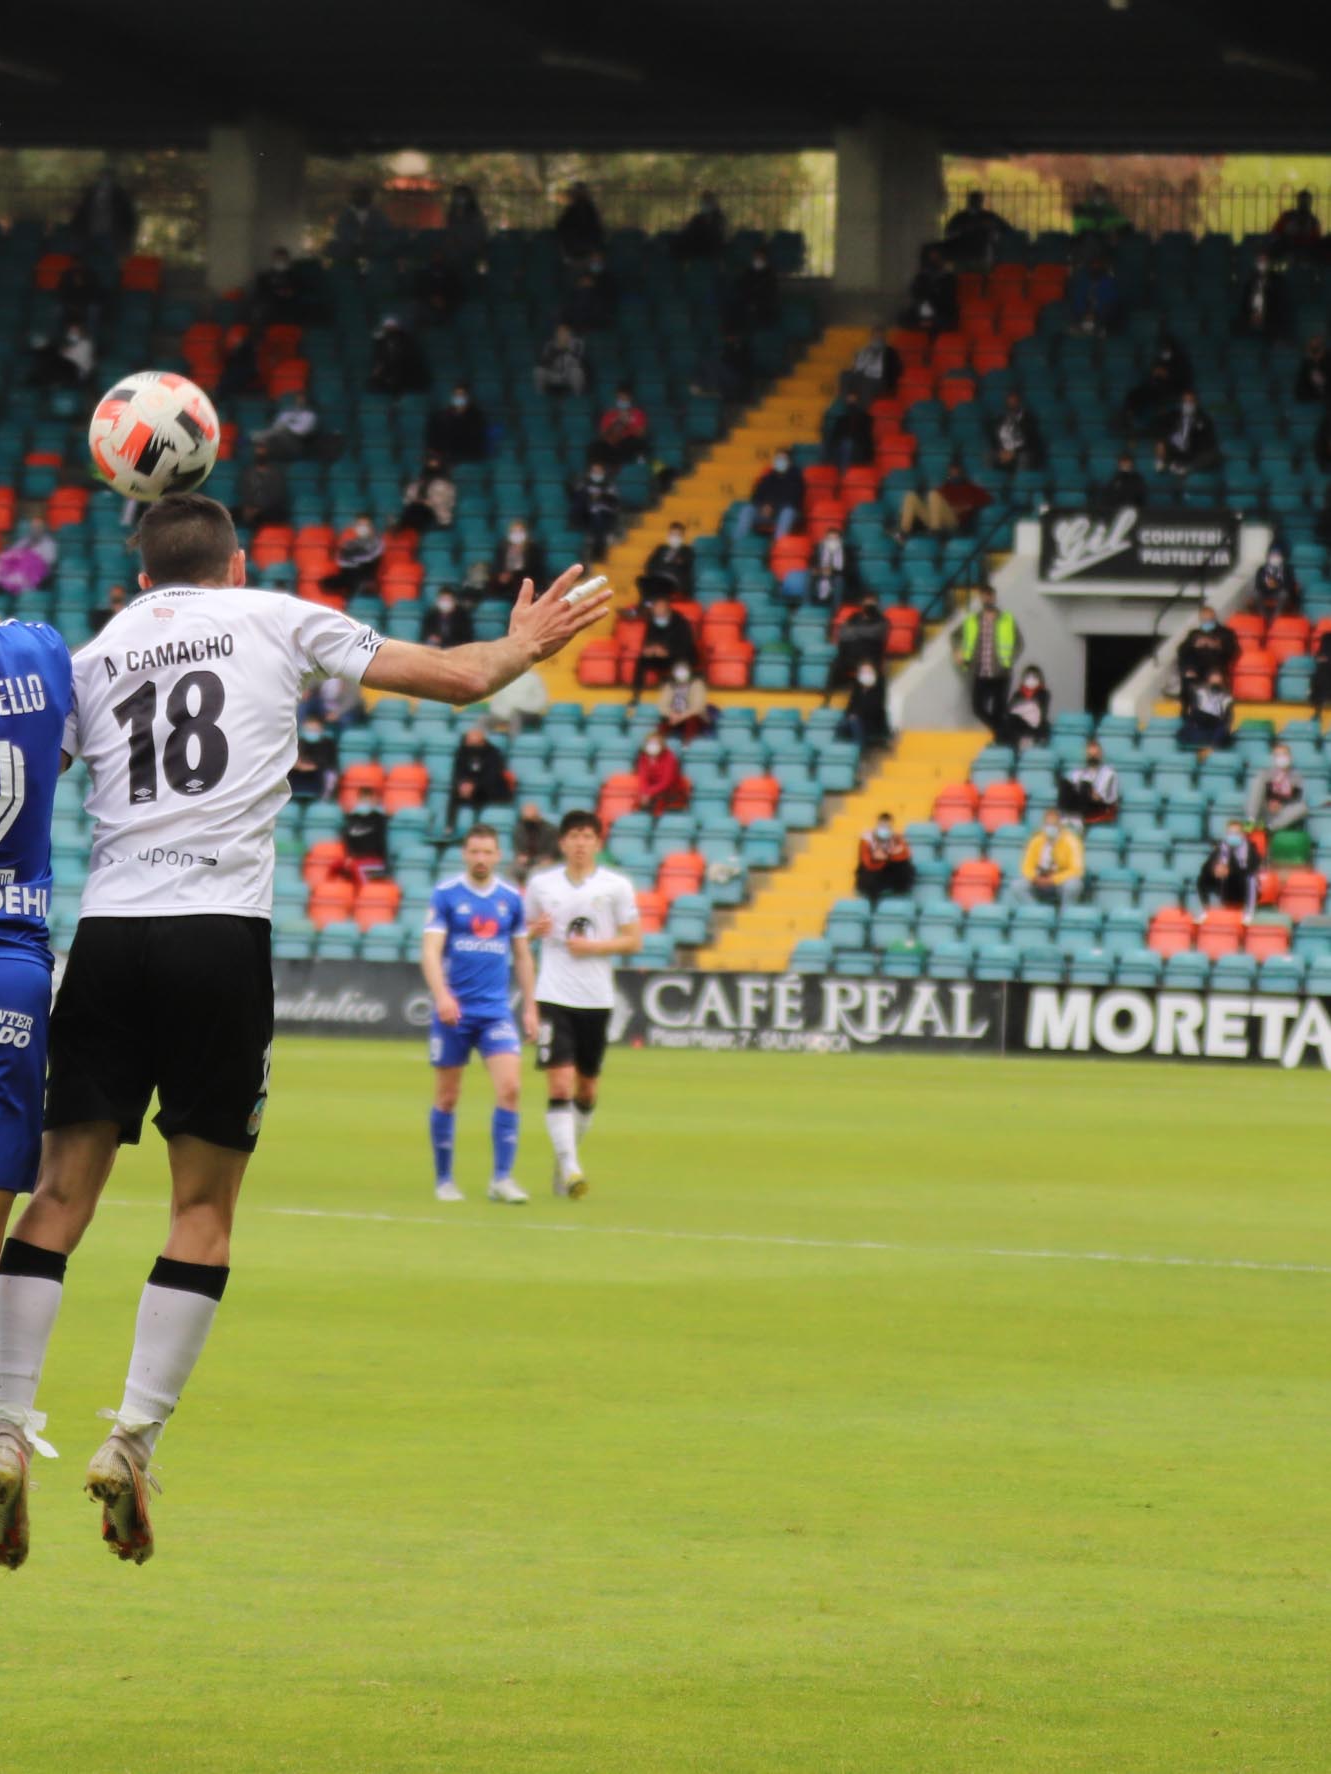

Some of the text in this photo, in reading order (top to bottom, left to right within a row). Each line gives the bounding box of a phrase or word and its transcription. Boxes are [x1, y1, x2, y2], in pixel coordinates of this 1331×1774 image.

[126, 633, 234, 672] CAMACHO
[111, 670, 229, 806] 18
[642, 974, 989, 1043] CAFÉ REAL
[1026, 985, 1331, 1070] MORETA
